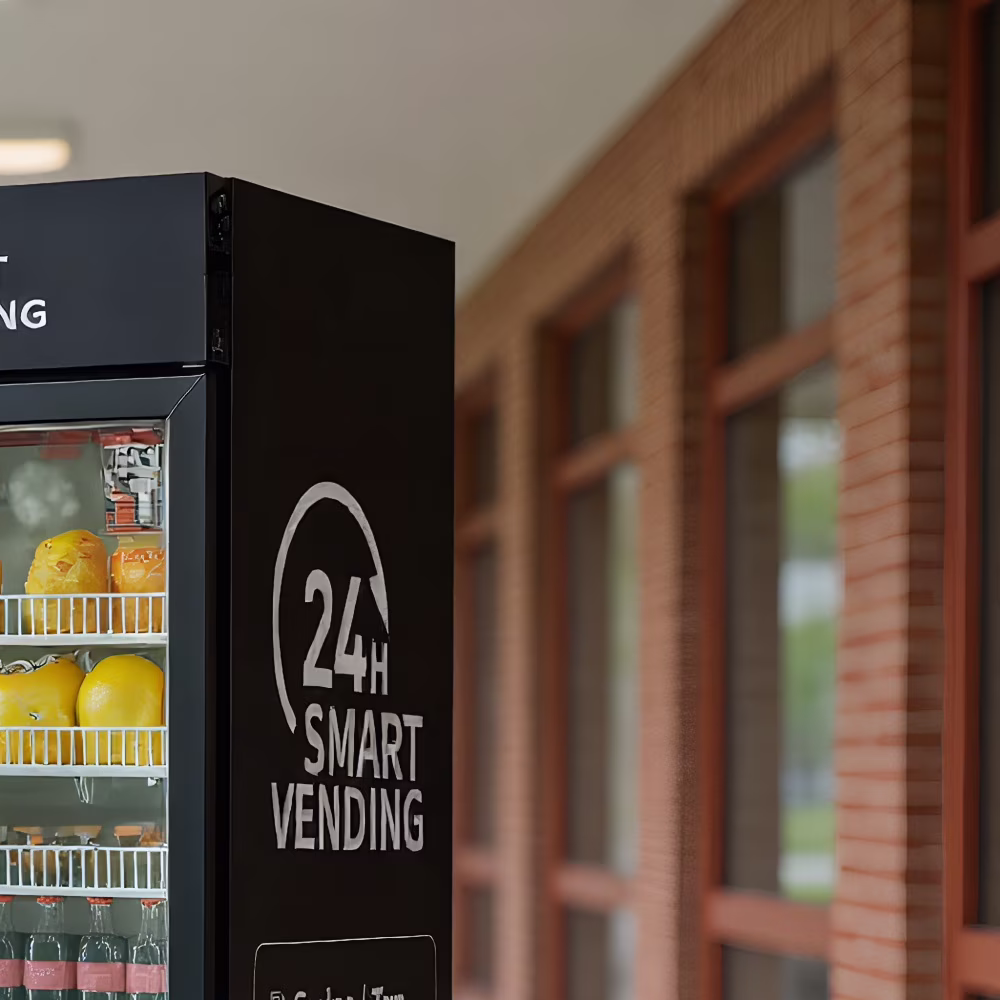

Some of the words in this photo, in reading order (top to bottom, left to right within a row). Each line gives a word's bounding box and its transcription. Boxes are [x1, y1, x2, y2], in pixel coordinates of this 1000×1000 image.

[302, 569, 389, 696] 24H
[304, 702, 424, 782] SMART
[271, 782, 424, 852] VENDING
